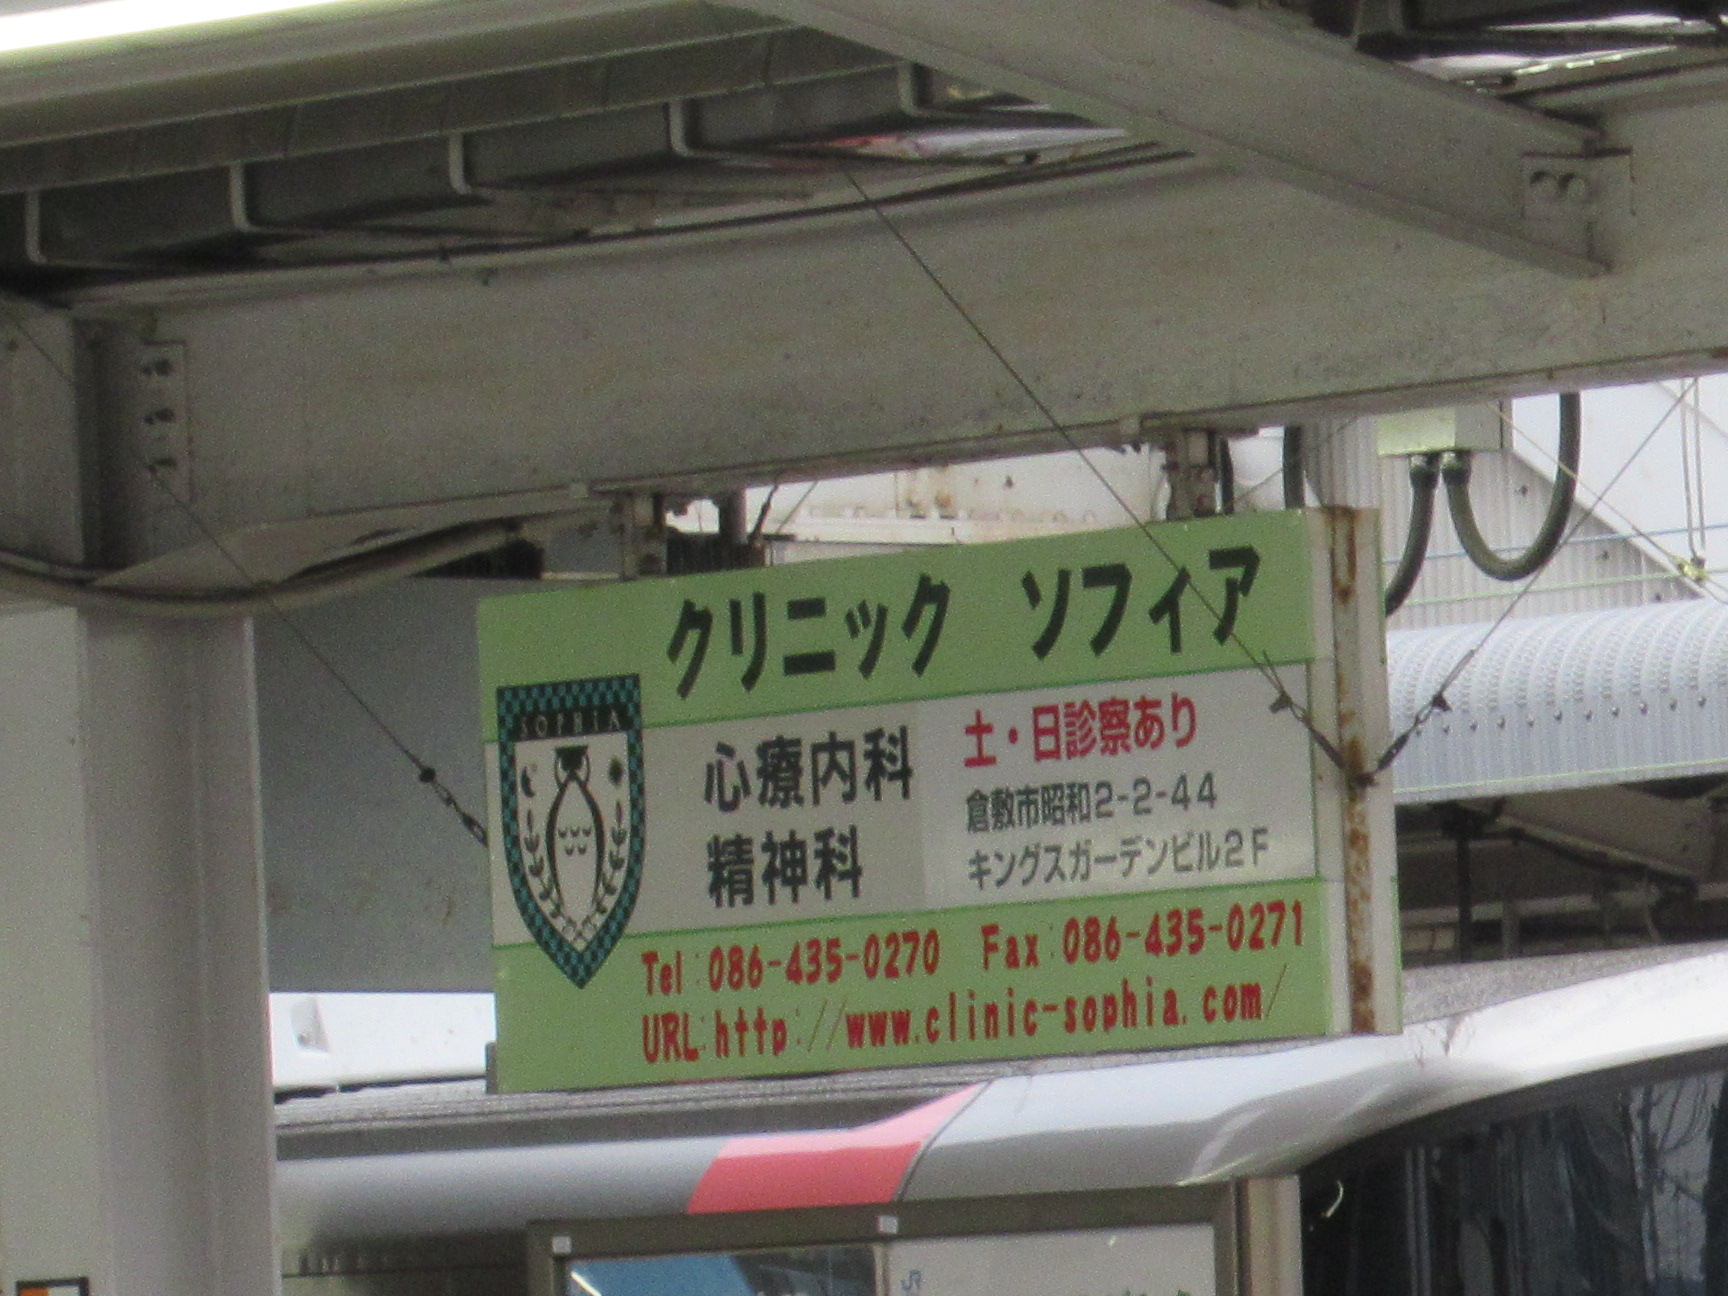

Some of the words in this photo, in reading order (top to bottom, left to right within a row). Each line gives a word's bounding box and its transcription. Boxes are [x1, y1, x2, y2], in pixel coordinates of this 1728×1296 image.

[667, 572, 950, 699] クリニック
[1022, 545, 1260, 660] ソフィア
[519, 710, 621, 739] SOPHIA
[963, 693, 1197, 768] 土・日診察あり
[704, 725, 914, 812] 心療内科
[966, 771, 1218, 834] 倉敷市昭和2-2-44
[705, 825, 862, 908] 精神科
